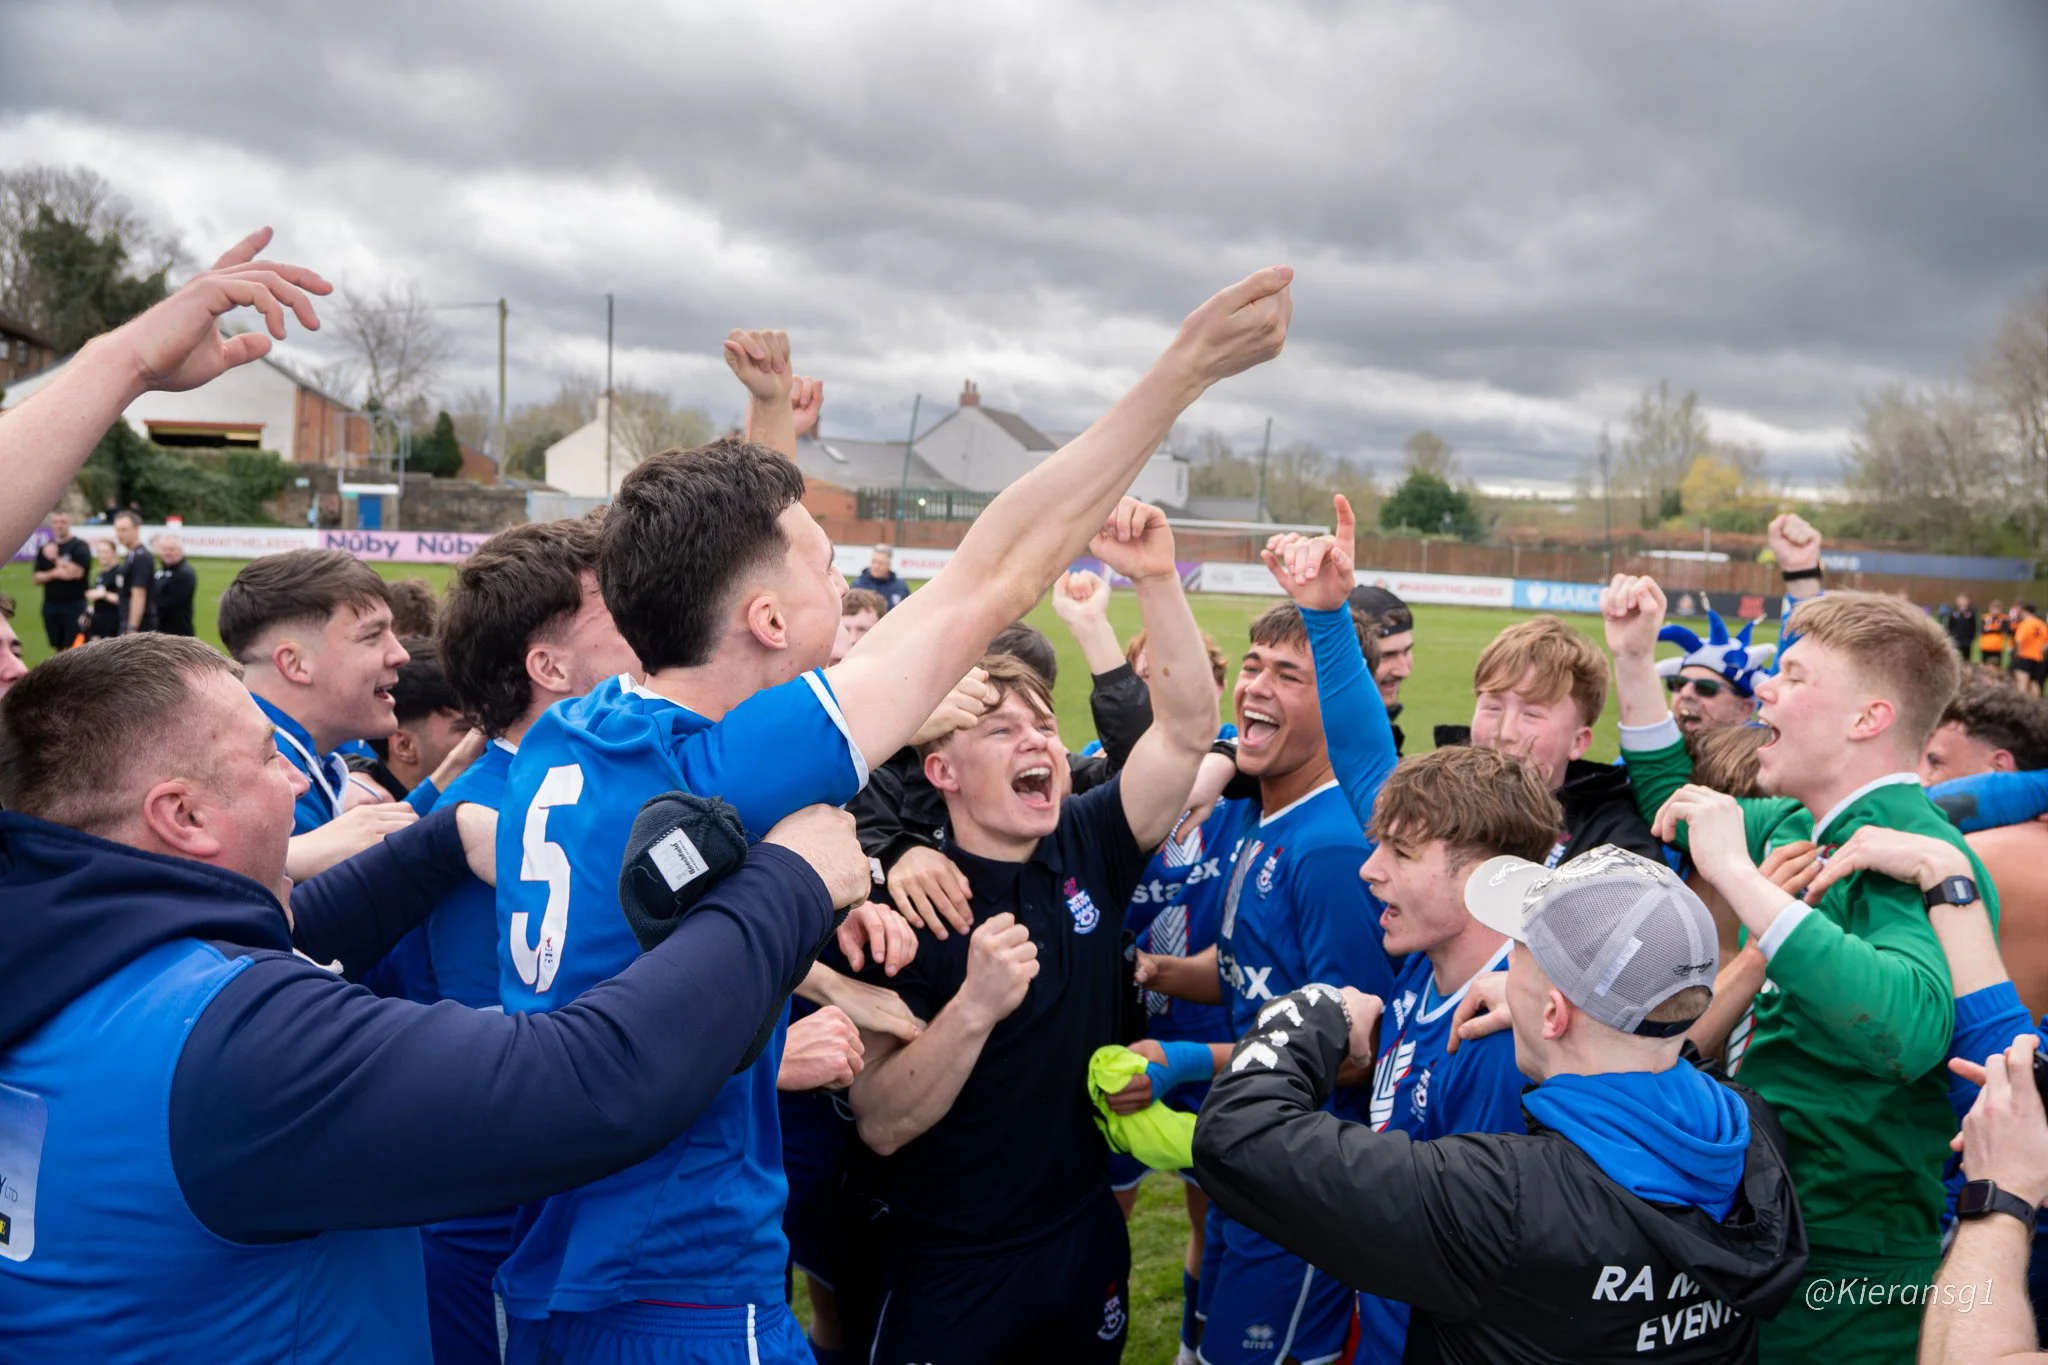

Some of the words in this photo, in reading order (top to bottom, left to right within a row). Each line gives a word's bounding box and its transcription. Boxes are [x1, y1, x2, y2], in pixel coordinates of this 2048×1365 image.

[417, 535, 480, 554] Nûb
[509, 763, 585, 994] 5
[1591, 1264, 1655, 1302] RA
[1636, 1299, 1742, 1352] EVEN
